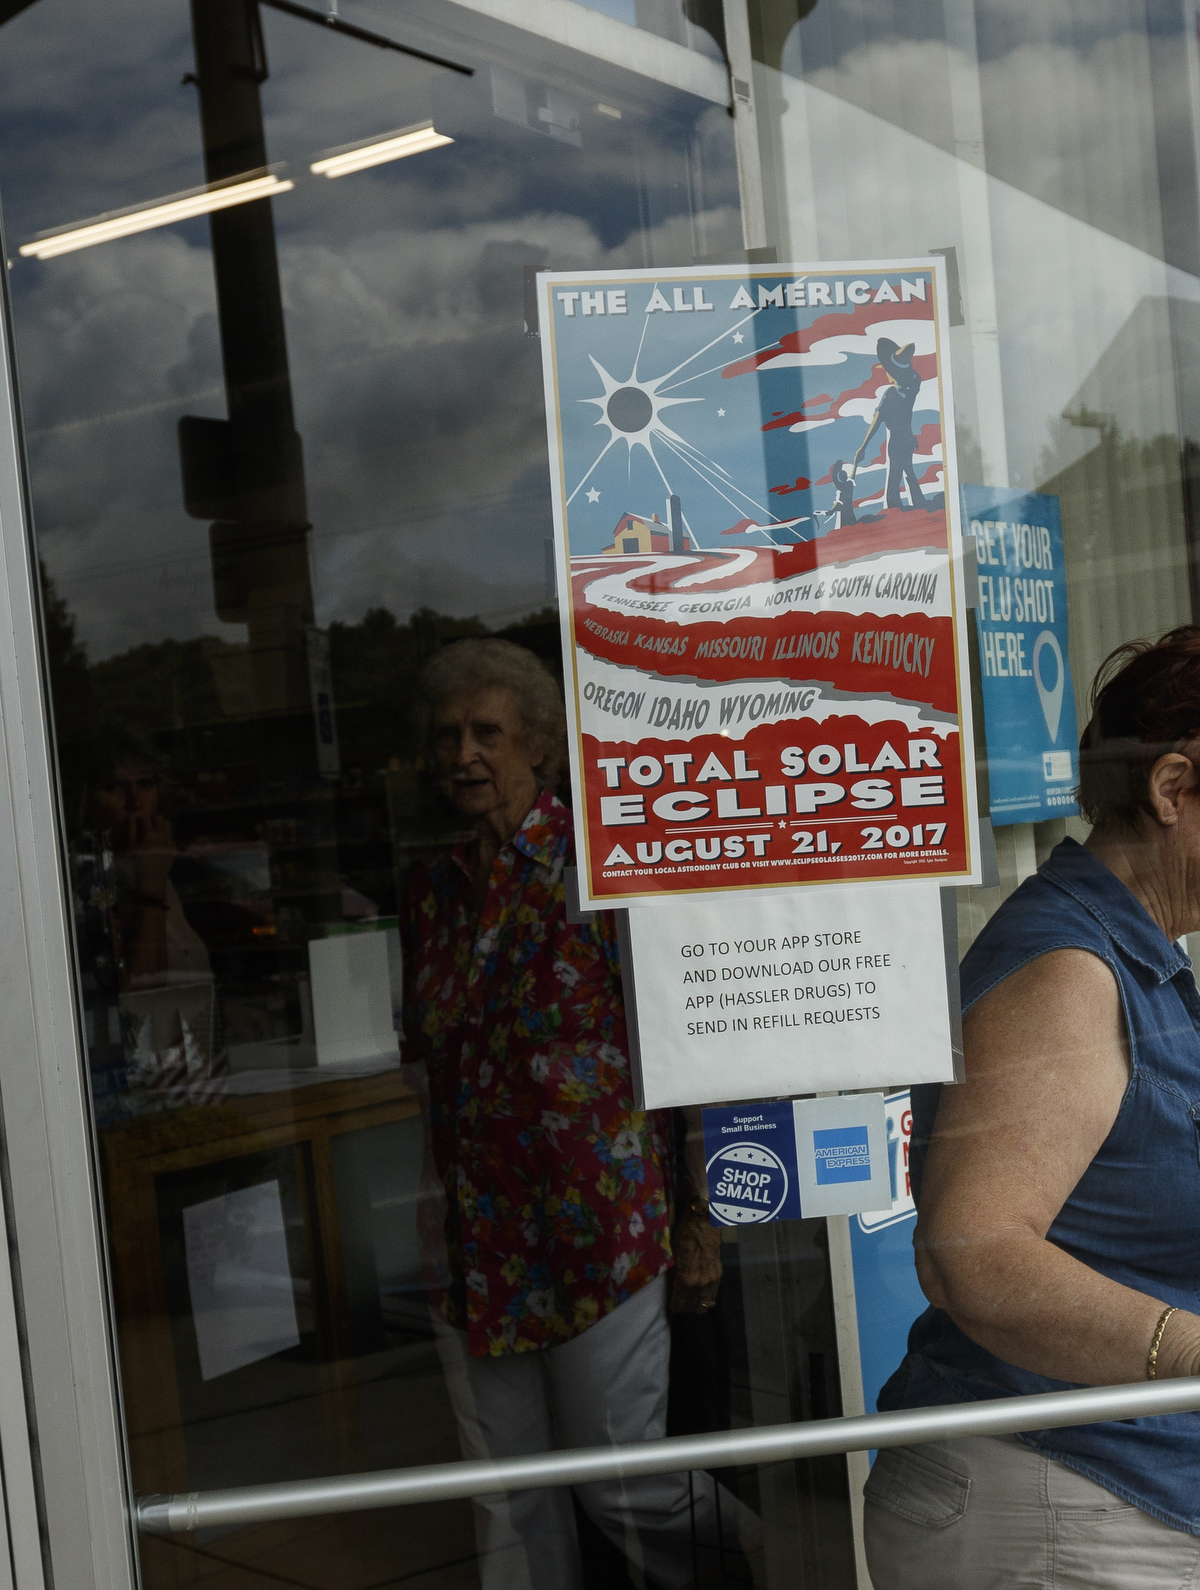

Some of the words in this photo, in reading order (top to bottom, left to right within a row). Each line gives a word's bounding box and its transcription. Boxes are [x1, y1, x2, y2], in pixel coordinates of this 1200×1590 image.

[558, 290, 628, 315] THE
[645, 286, 714, 313] ALL
[730, 277, 926, 310] AMERICAN
[970, 518, 1008, 566] GET
[1011, 521, 1054, 571] YOUR
[602, 594, 674, 612] TENNESSEE
[678, 595, 752, 613] GEORGIA
[764, 584, 812, 607] NORTH
[814, 581, 825, 599] &
[829, 574, 874, 598] SOUTH
[875, 572, 938, 604] CAROLINA
[978, 575, 1011, 623] FLU
[1014, 578, 1056, 624] SHOT
[583, 618, 630, 646] NEBRASKA
[634, 634, 689, 656] KANSAS
[694, 636, 767, 660] MISSOURI
[772, 630, 840, 660] ILLINOIS
[851, 630, 936, 678] KENTUCKY
[982, 631, 1034, 678] HERE.
[582, 680, 646, 720] OREGON
[647, 696, 708, 732] IDAHO
[720, 688, 816, 726] WYOMING
[597, 749, 760, 789] TOTAL
[780, 738, 944, 779] SOLAR
[600, 775, 946, 827] ECLIPSE
[603, 833, 772, 867] AUGUST
[791, 829, 843, 856] 21,
[860, 822, 949, 852] 2017
[602, 869, 632, 878] CONTACT
[634, 868, 654, 876] YOUR
[654, 866, 676, 875] LOCAL
[677, 864, 721, 873] ASTRONOMY
[722, 862, 739, 870] CLUB
[740, 861, 751, 869] OR
[752, 860, 770, 868] VISIT
[770, 852, 883, 867] WWW.ECLIPSEGLASSES2017.COM
[884, 852, 898, 860] FOR
[899, 850, 920, 858] MORE
[920, 849, 950, 857] DETAILS.
[680, 944, 705, 958] GO
[708, 942, 730, 956] TO
[733, 938, 777, 954] YOUR
[781, 935, 810, 950] APP
[814, 930, 862, 948] STORE
[682, 969, 717, 984] AND
[722, 960, 814, 982] DOWNLOAD
[818, 957, 852, 973] OUR
[856, 954, 892, 970] FREE
[685, 994, 714, 1010] APP
[719, 988, 790, 1010] (HASSLER
[794, 982, 852, 1001] DRUGS)
[854, 981, 876, 995] TO
[687, 1020, 728, 1036] SEND
[732, 1018, 748, 1032] IN
[753, 1013, 800, 1030] REFILL
[804, 1006, 880, 1026] REQUESTS
[721, 1126, 742, 1134] Small
[744, 1122, 777, 1132] Business
[733, 1114, 764, 1124] Support
[815, 1145, 866, 1158] AMERICAN
[826, 1156, 870, 1169] EXPRESS
[722, 1167, 771, 1188] SHOP
[715, 1182, 772, 1204] SMALL
